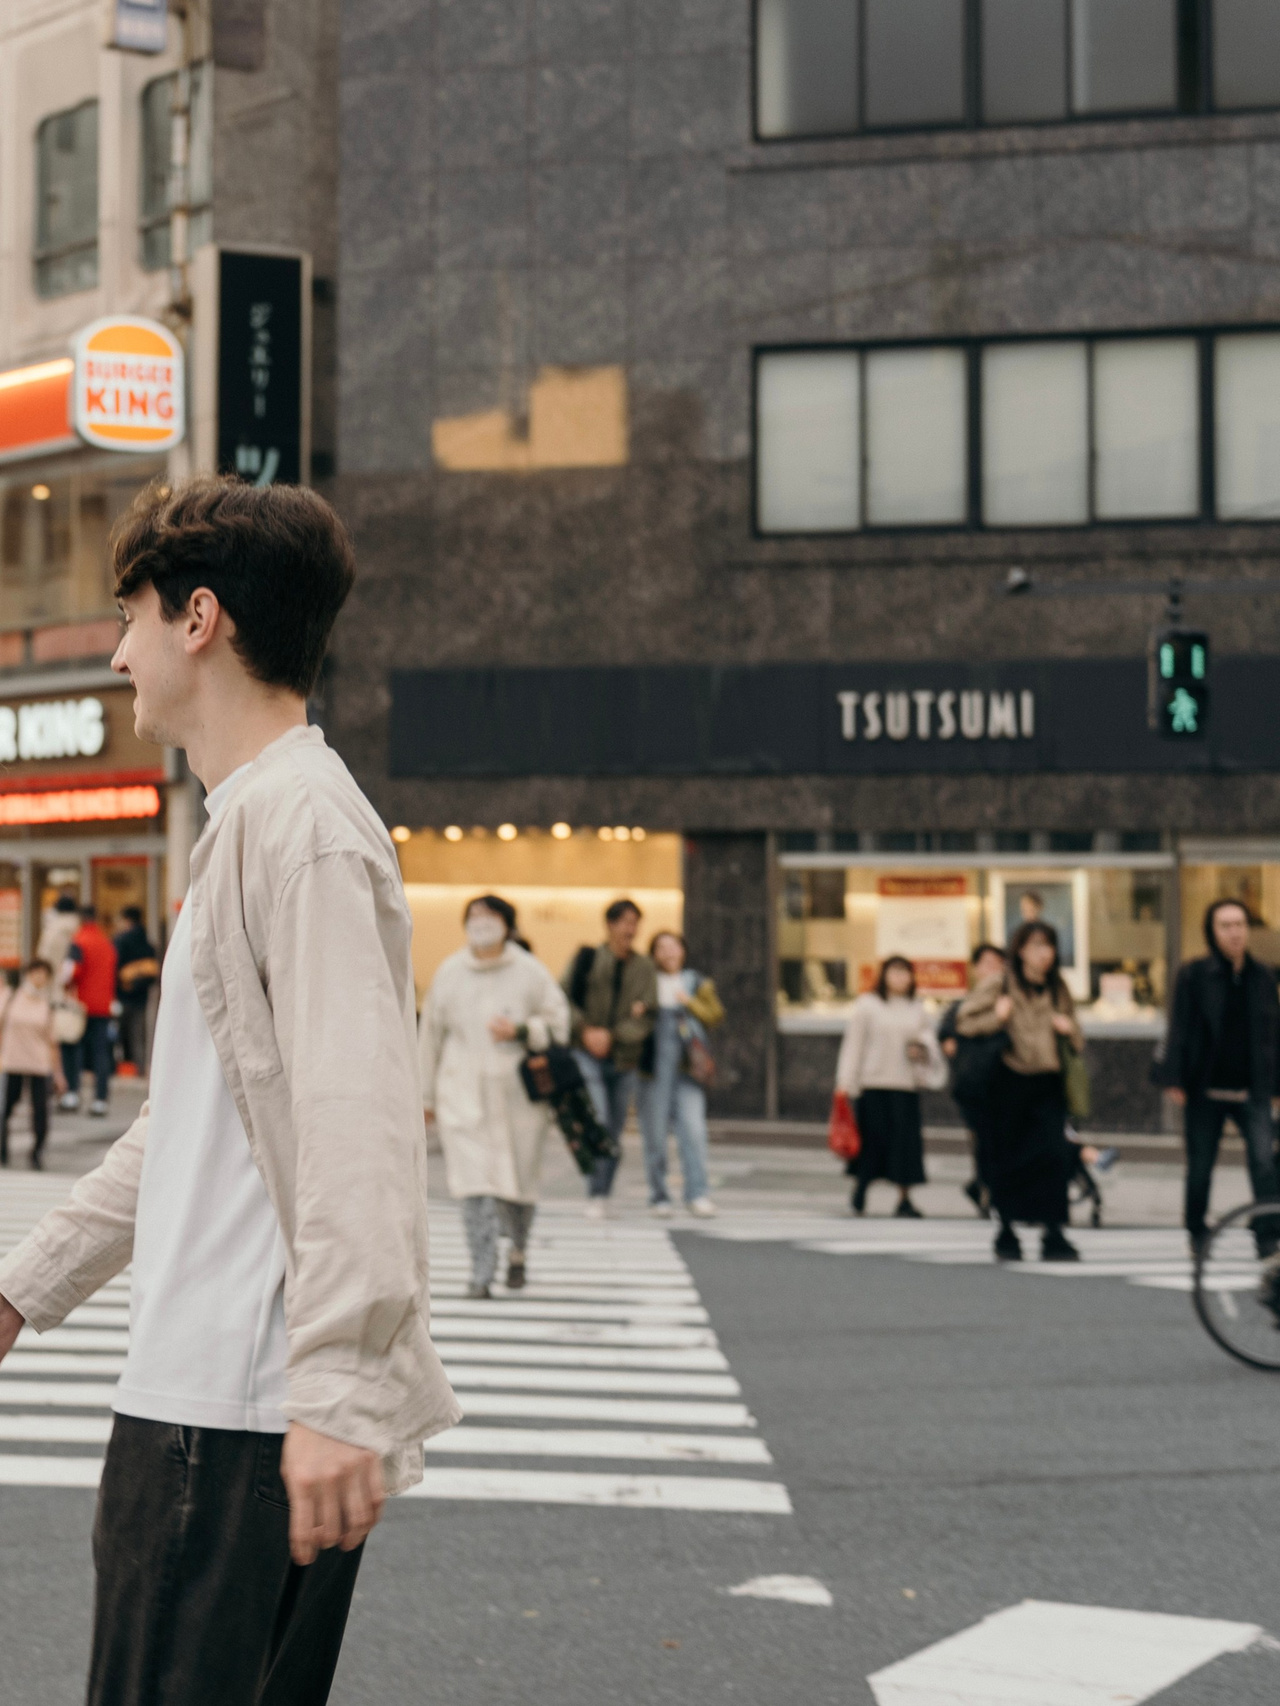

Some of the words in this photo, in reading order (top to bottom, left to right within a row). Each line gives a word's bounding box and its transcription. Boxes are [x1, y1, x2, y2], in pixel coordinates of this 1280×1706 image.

[86, 360, 172, 383] BURGER
[248, 302, 273, 420] ジュエリー
[86, 387, 174, 420] KING
[18, 697, 105, 760] KING
[836, 689, 1035, 741] TSUTSUMI
